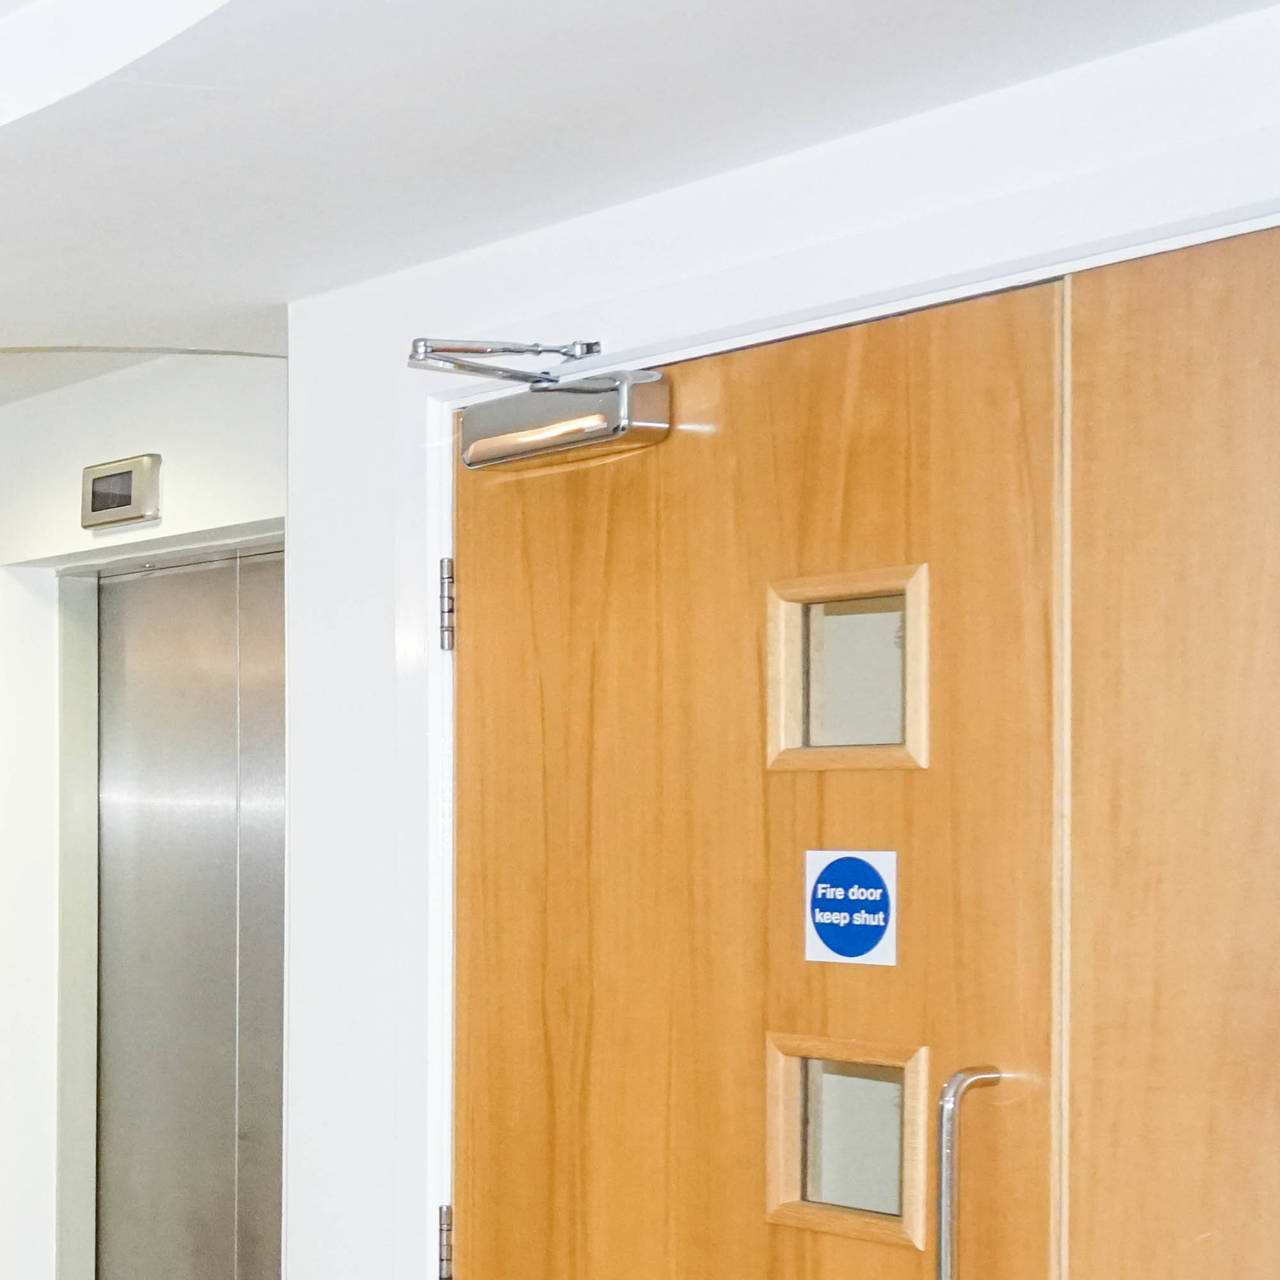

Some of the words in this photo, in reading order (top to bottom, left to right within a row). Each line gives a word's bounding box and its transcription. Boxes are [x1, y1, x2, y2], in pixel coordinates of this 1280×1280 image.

[816, 883, 845, 900] Fire
[848, 884, 883, 901] door
[814, 908, 850, 927] keep
[852, 909, 886, 926] shut
